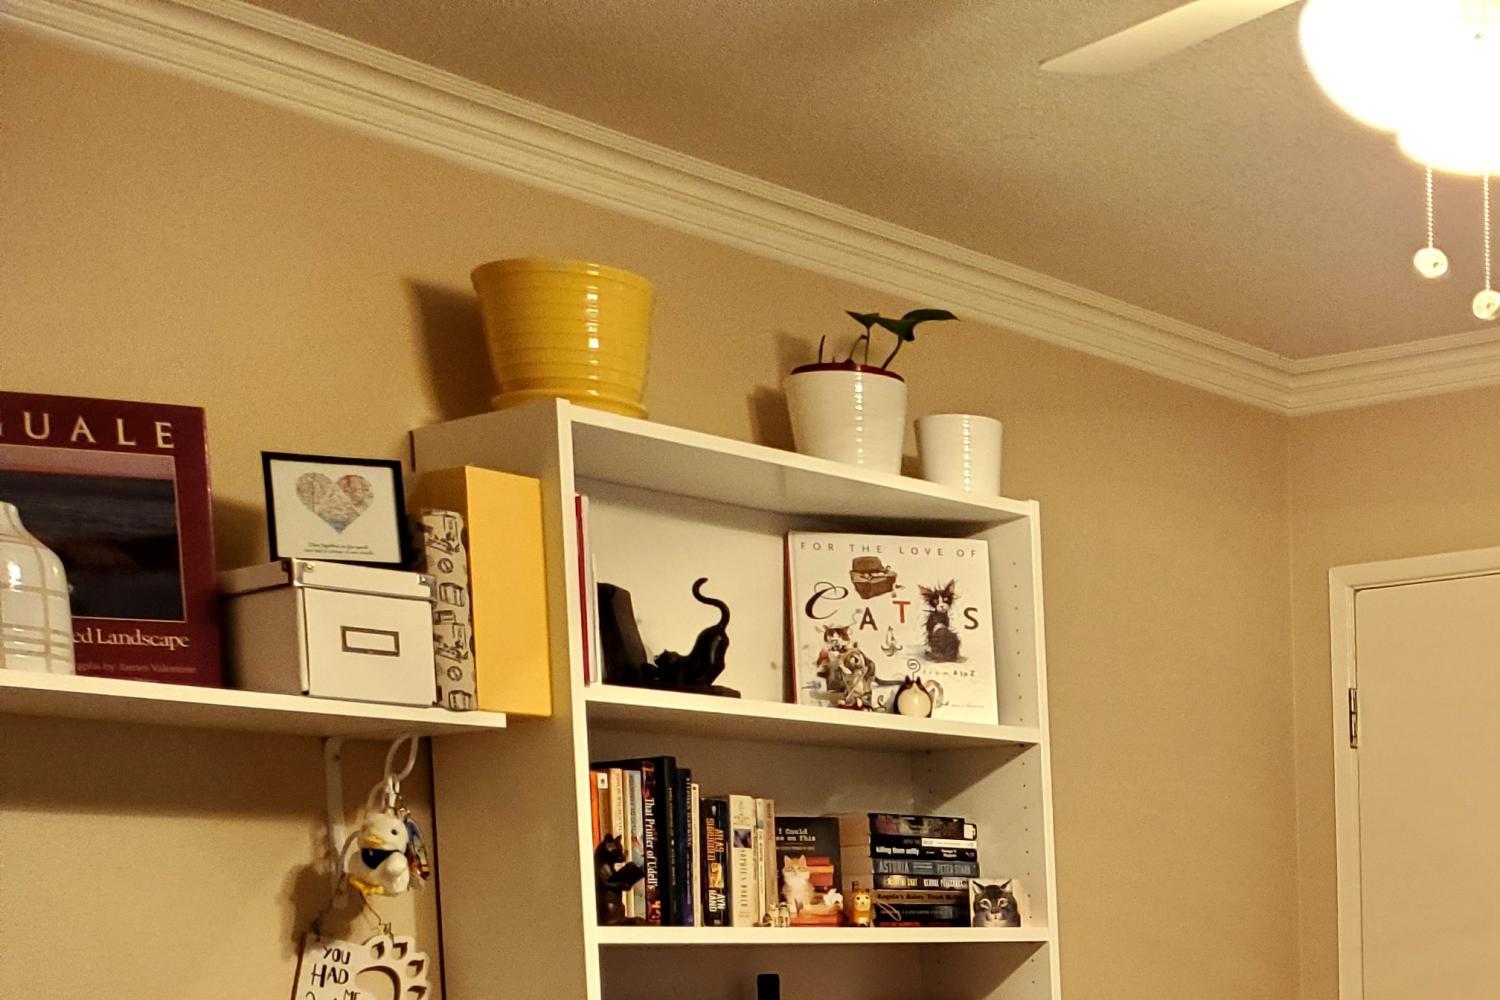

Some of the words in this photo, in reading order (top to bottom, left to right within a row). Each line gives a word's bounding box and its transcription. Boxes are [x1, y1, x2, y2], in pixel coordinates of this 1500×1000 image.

[0, 410, 175, 450] UALE
[800, 541, 835, 551] FOR
[849, 543, 883, 554] THE
[899, 545, 944, 557] LOVE
[956, 548, 977, 558] OF
[804, 581, 980, 632] CATS
[96, 628, 191, 650] Landscape
[644, 797, 656, 816] That
[645, 818, 657, 849] Printer
[715, 828, 725, 853] ATLAS
[647, 850, 657, 860] of
[646, 861, 658, 890] Udell's
[879, 861, 910, 873] ASTORIA
[708, 889, 718, 913] RAND
[716, 893, 727, 910] AYN
[323, 945, 351, 965] YOU
[311, 963, 349, 988] HAD
